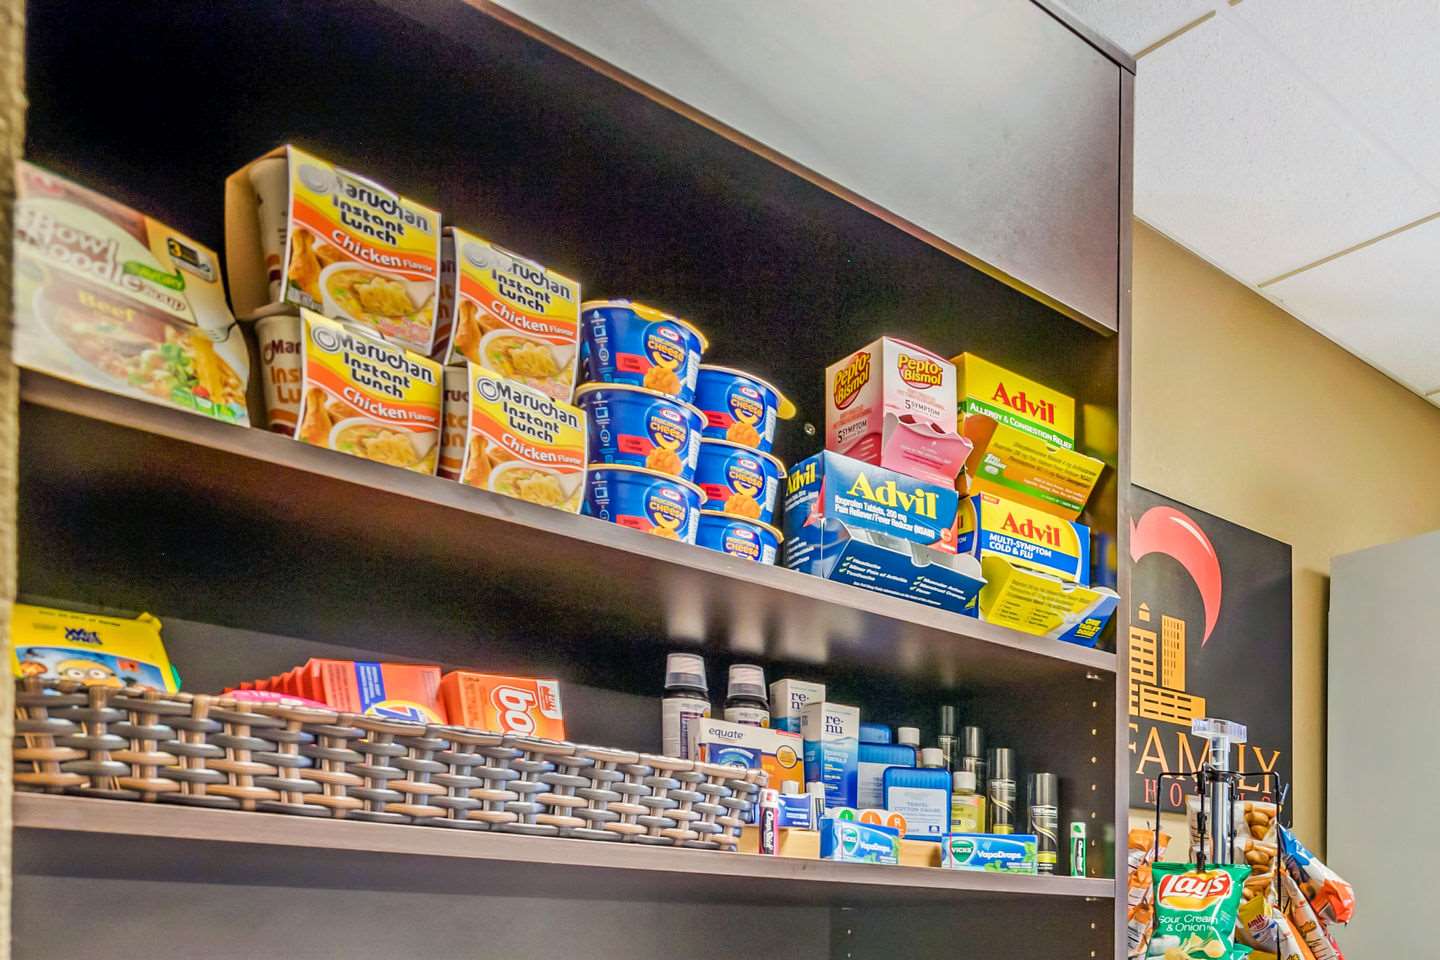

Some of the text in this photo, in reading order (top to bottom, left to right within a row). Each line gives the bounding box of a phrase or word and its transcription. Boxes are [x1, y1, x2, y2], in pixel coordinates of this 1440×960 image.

[333, 195, 404, 235] Instant
[341, 212, 397, 246] Lunch
[332, 230, 402, 267] Chicken
[491, 269, 551, 304] Instant
[499, 284, 545, 313] Lunch
[491, 300, 549, 333] Chicken
[340, 335, 434, 383] Maruchan
[344, 352, 411, 389] Instant
[835, 352, 871, 385] Pepto-
[898, 353, 943, 373] Pepto-
[352, 369, 403, 399] Lunch
[837, 363, 870, 403] Bismol
[903, 369, 943, 387] Bismol
[343, 386, 408, 420] Chicken
[496, 380, 578, 428] Maruchan
[503, 402, 560, 433] Instant
[992, 382, 1056, 425] Advil
[509, 416, 553, 443] Lunch
[501, 432, 557, 462] Chicken
[786, 463, 816, 497] Advil
[847, 472, 939, 520] Advil
[989, 533, 1052, 557] MULTI-SYMPTOM
[1000, 511, 1061, 547] Advil
[989, 541, 1012, 554] COLD
[1020, 549, 1034, 560] FLU
[708, 727, 744, 741] equate
[825, 724, 843, 734] nu
[1128, 722, 1281, 795] AMLY
[976, 850, 1024, 860] VapoDrops
[1160, 914, 1218, 924] Sour Cream
[1175, 923, 1206, 932] Onion
